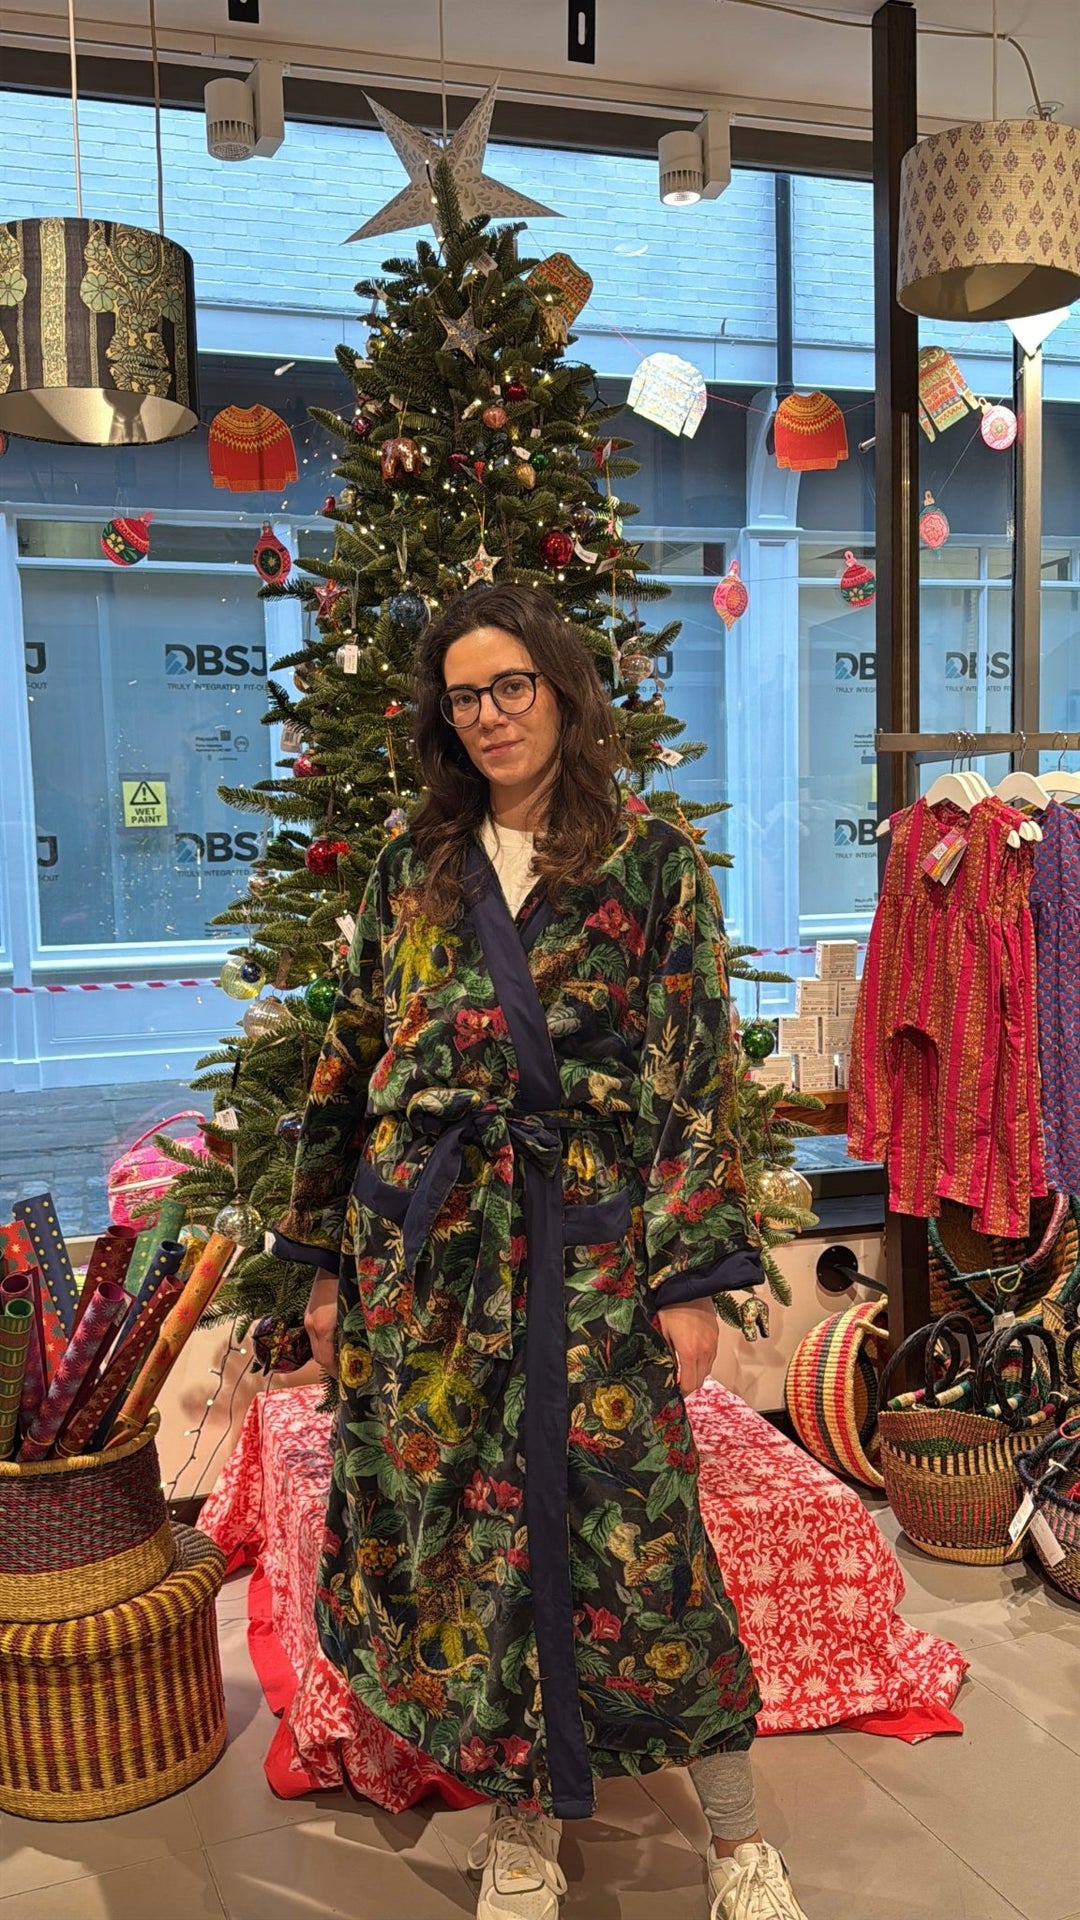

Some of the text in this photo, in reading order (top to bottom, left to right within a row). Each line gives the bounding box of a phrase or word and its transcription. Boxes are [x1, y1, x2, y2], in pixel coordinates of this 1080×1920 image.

[165, 644, 267, 676] DBSJ
[835, 652, 877, 680] DB
[945, 651, 1010, 679] DBS
[131, 815, 161, 823] PAINT
[134, 807, 156, 816] WET
[834, 819, 877, 846] DB
[175, 831, 272, 863] DBS
